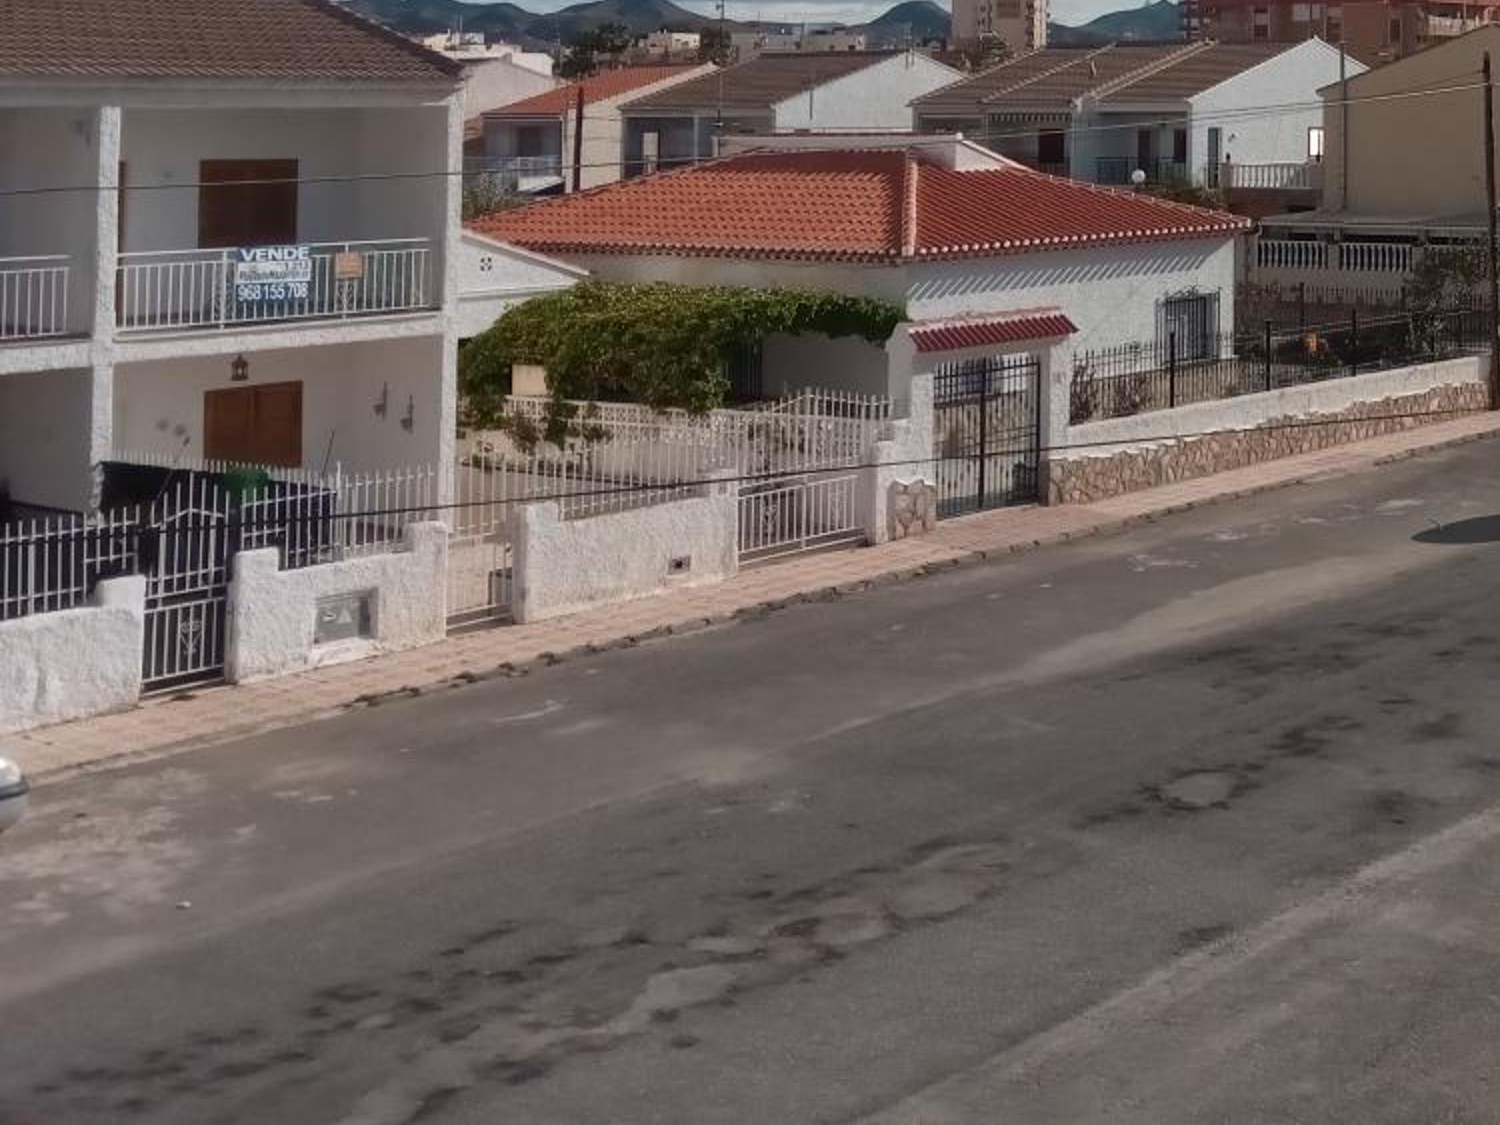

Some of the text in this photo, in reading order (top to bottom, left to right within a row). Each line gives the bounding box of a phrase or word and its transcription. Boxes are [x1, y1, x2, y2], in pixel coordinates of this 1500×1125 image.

[241, 246, 309, 261] VENDE
[238, 282, 308, 301] 968 155 708
